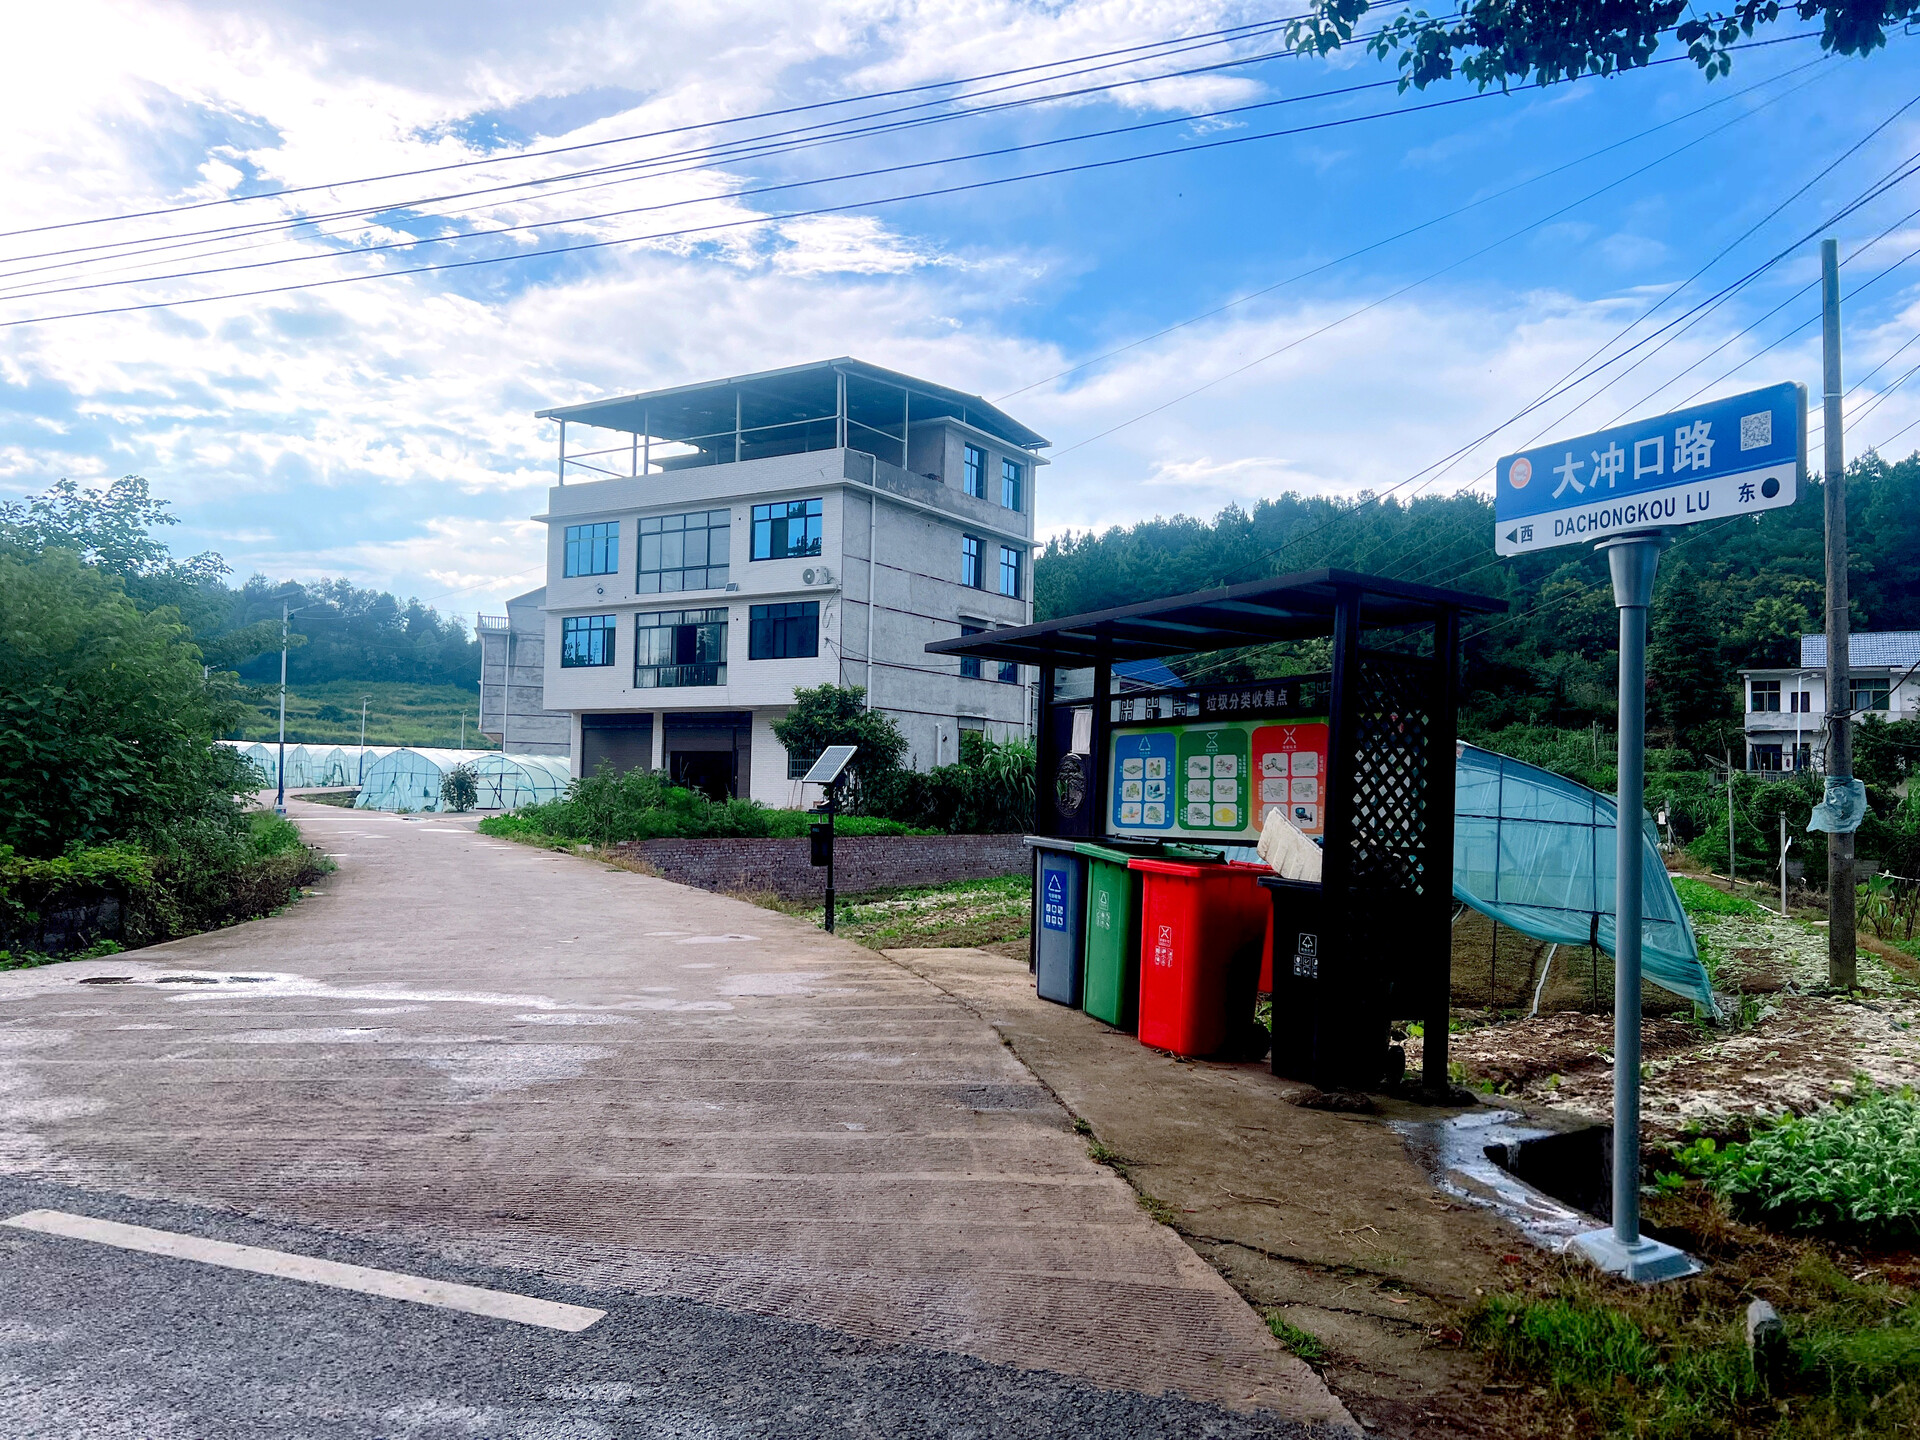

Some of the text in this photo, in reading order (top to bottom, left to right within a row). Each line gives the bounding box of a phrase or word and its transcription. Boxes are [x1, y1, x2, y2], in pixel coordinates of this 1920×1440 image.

[1552, 420, 1716, 499] 大冲口路
[1738, 482, 1756, 503] 东
[1554, 490, 1710, 538] DACHONGKOU LU
[1519, 524, 1535, 544] 西
[1206, 688, 1288, 712] 垃圾分类收集点
